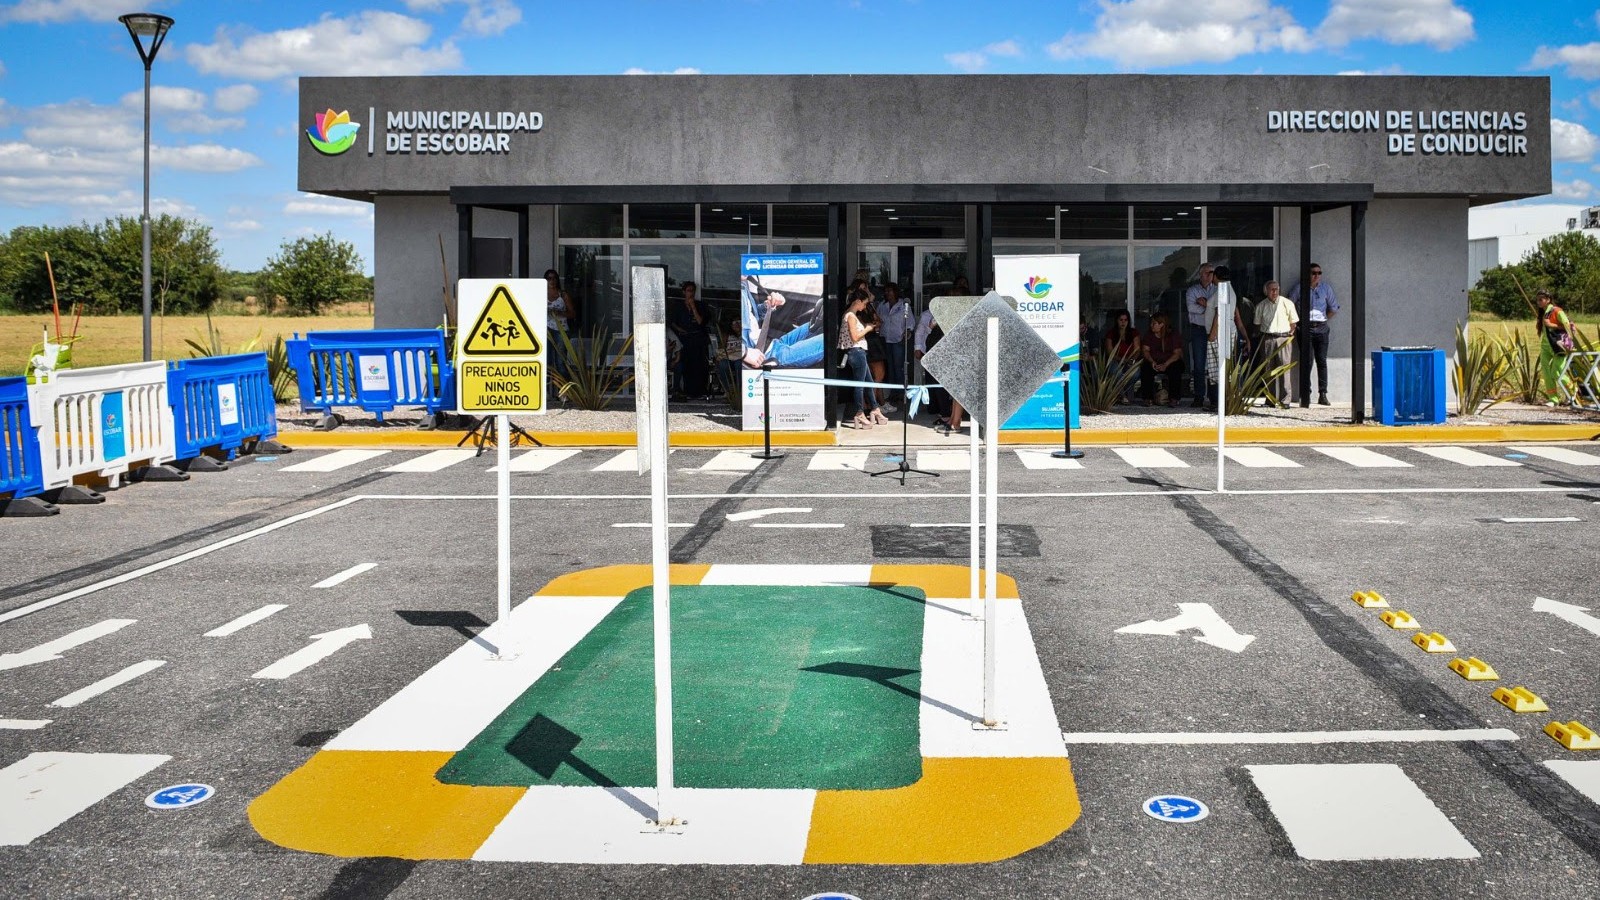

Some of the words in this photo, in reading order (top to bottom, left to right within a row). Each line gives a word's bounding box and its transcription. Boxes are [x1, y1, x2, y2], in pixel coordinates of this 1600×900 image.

[387, 111, 543, 130] MUNICIPALIDAD
[1268, 110, 1380, 130] DIRECCION
[1386, 110, 1413, 130] DE
[1419, 111, 1528, 130] LICENCIAS
[386, 133, 412, 152] DE
[416, 133, 510, 152] ESCOBAR
[1388, 134, 1416, 153] DE
[1422, 134, 1528, 153] CONDUCIR
[1016, 301, 1065, 312] SCOBAR
[465, 366, 537, 377] PRECAUCION
[475, 395, 529, 406] JUGANDO
